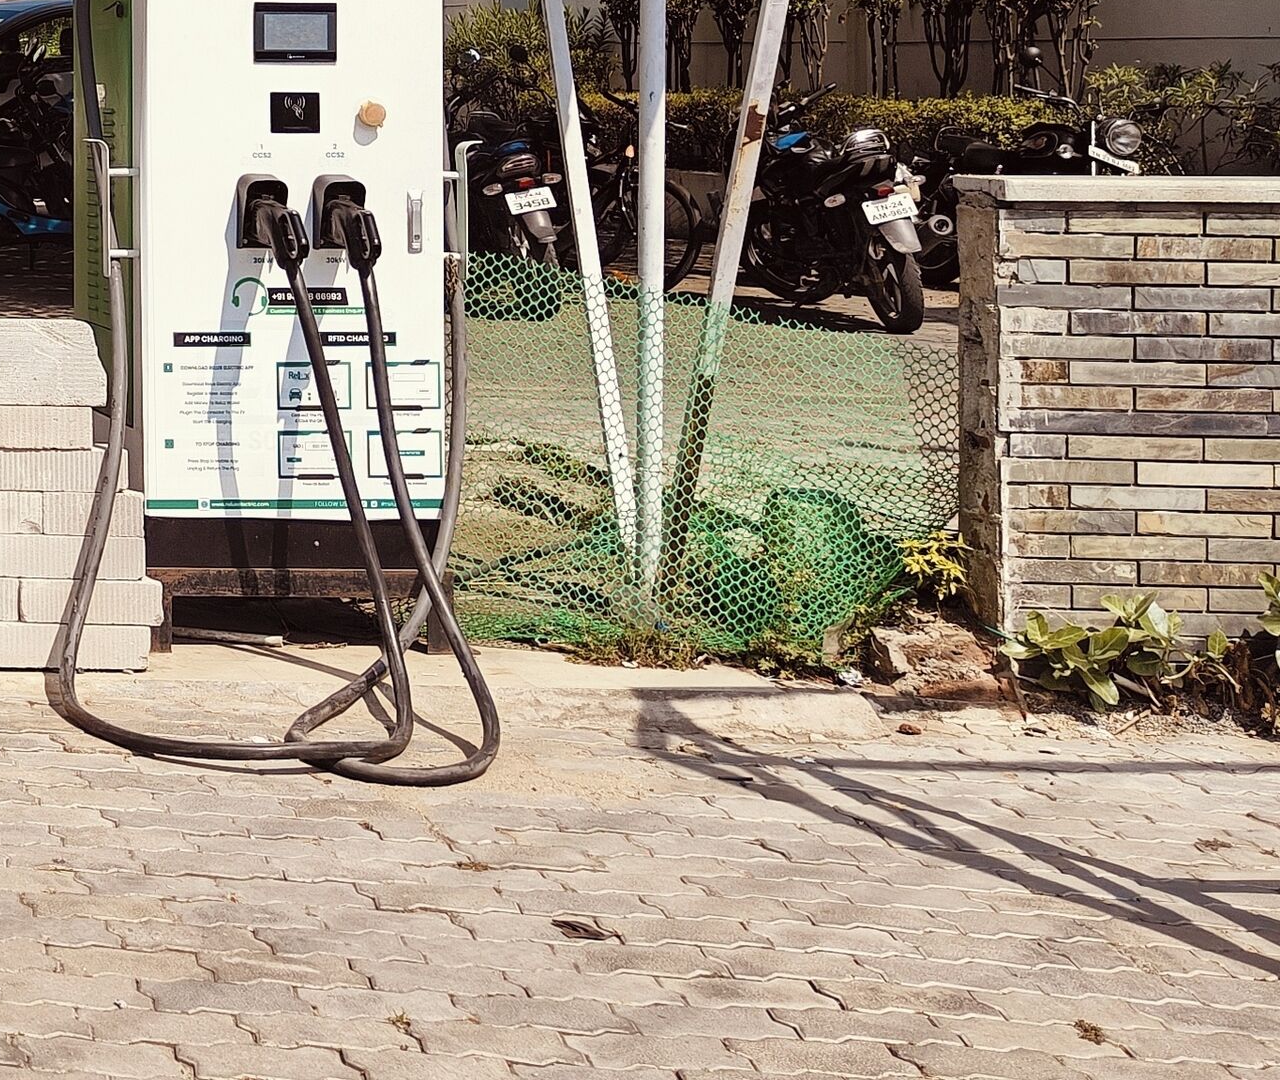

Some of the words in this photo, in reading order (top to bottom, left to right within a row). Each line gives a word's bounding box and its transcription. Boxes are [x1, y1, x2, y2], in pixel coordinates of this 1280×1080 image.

[513, 197, 550, 210] 3458
[184, 335, 200, 343] APP
[201, 335, 244, 343] CHARGING
